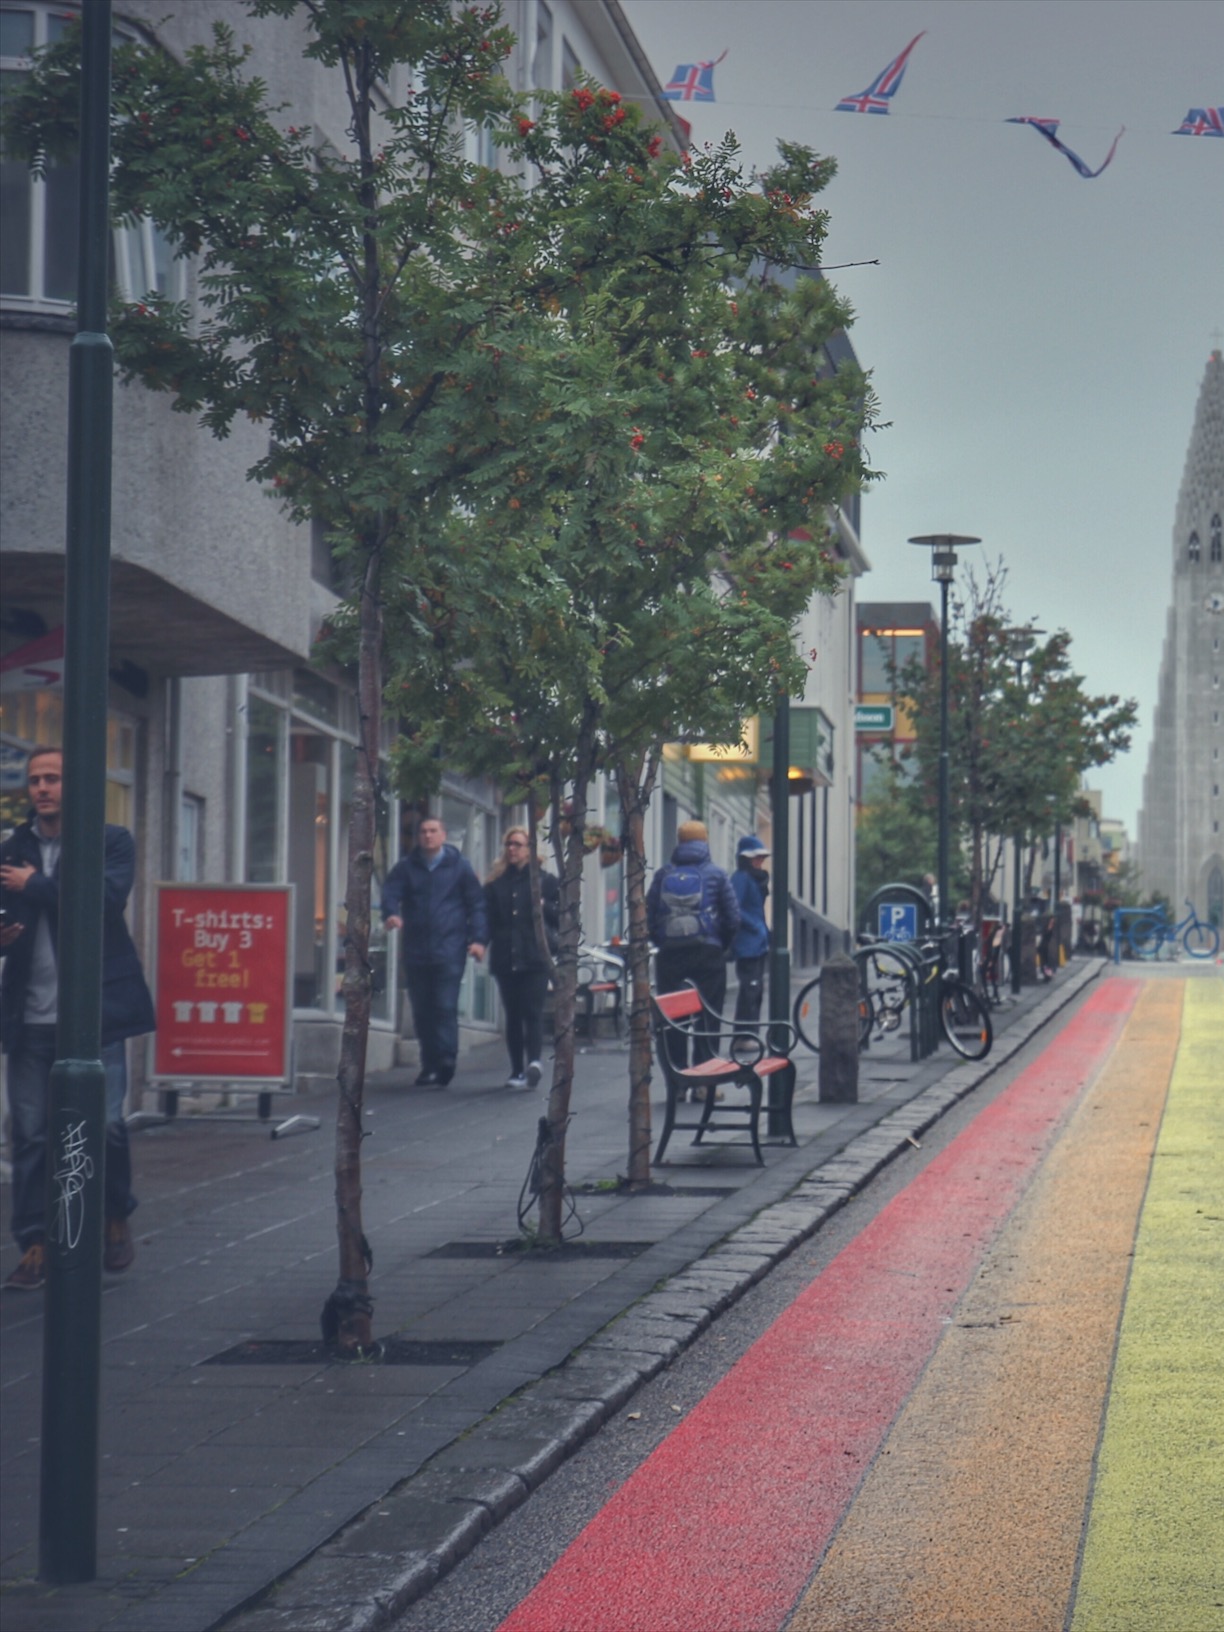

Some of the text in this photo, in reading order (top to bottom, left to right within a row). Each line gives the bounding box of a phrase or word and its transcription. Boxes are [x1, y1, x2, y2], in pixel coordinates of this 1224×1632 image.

[172, 909, 273, 929] T-shirts:
[891, 907, 905, 925] P
[194, 930, 252, 952] Buy 3
[182, 951, 240, 968] Get 1
[195, 969, 249, 988] free!
